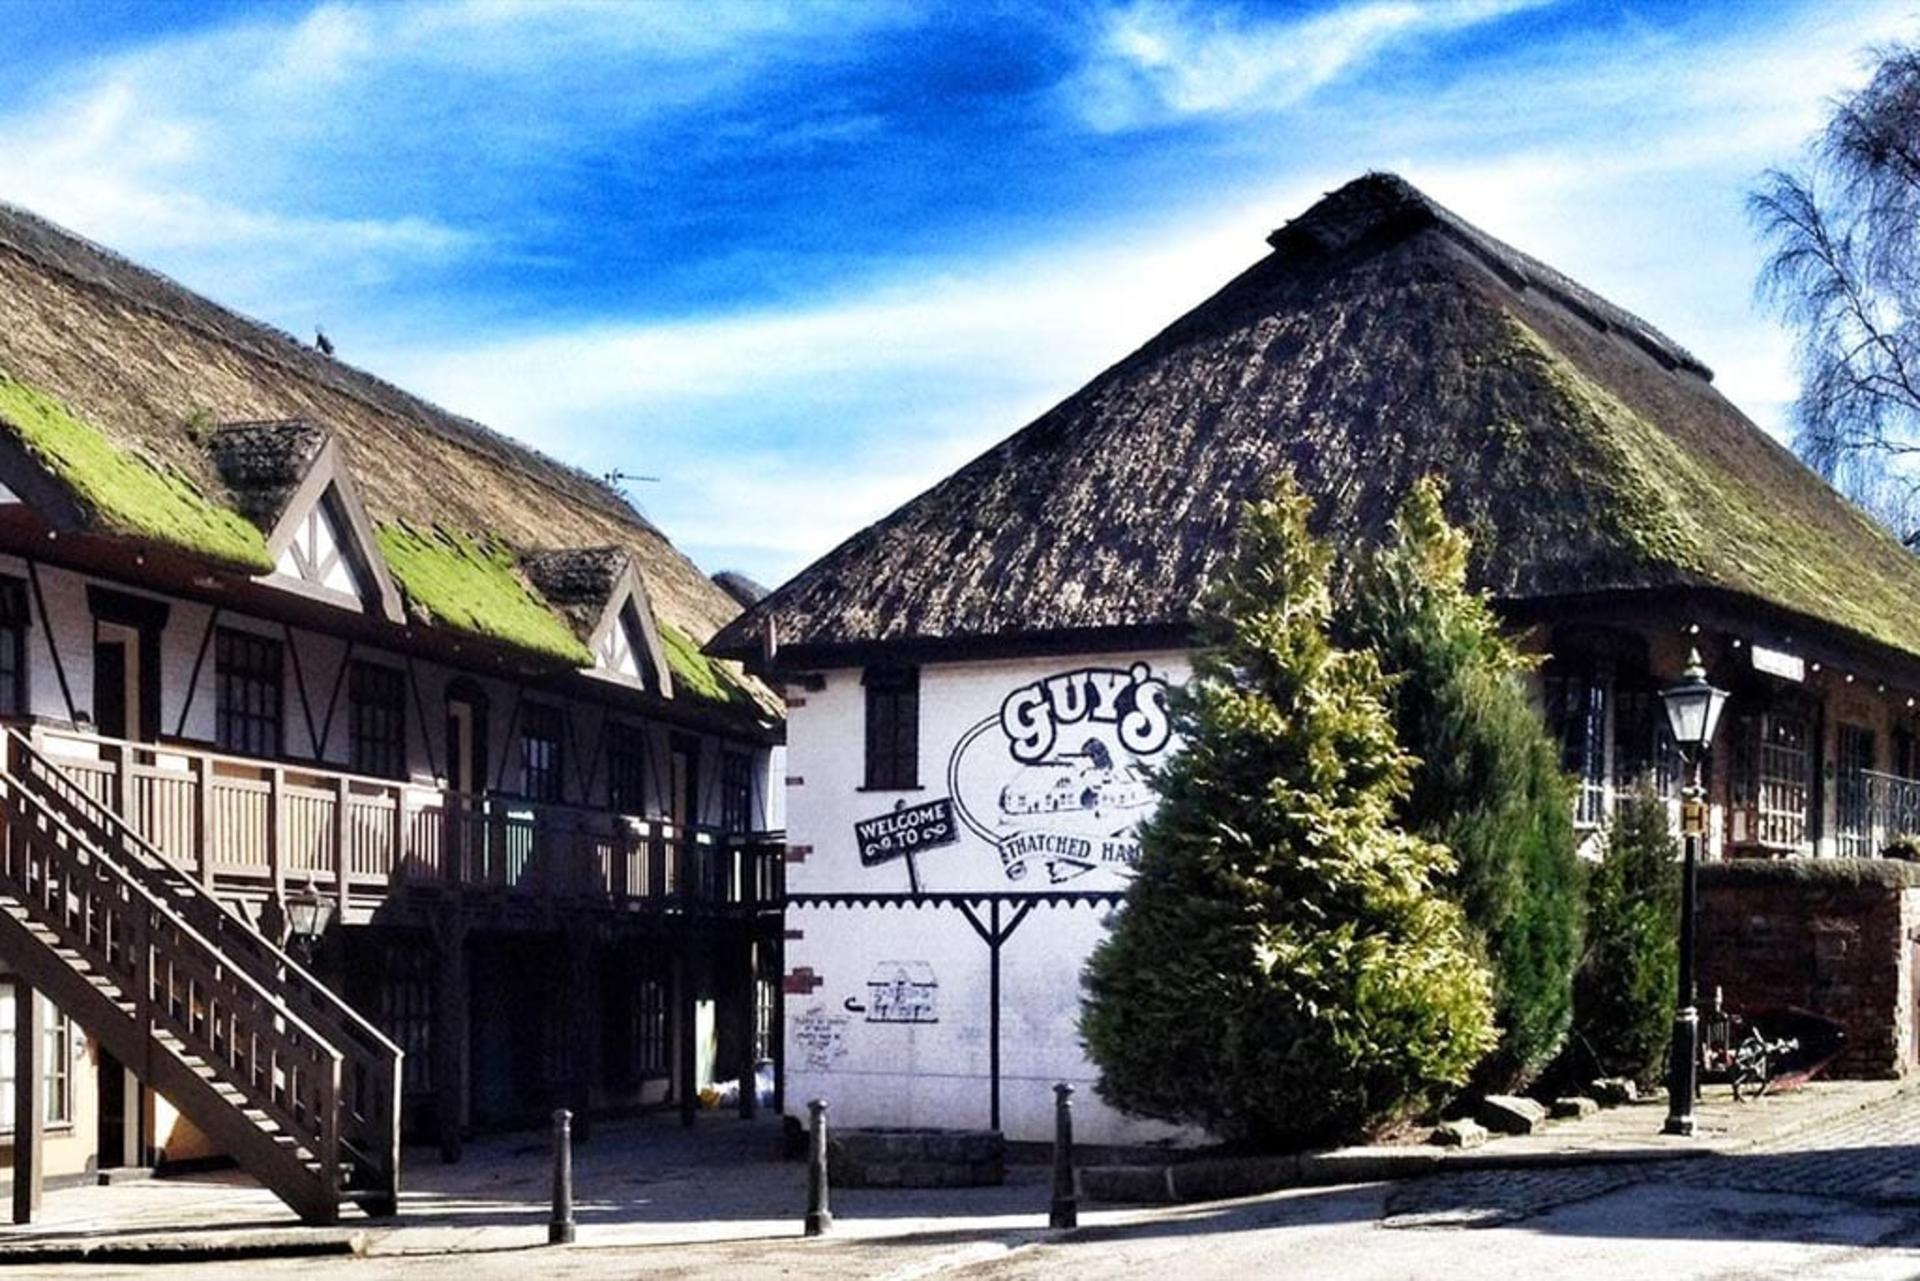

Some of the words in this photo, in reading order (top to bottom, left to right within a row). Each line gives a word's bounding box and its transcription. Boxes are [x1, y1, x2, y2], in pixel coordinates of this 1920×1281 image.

[1001, 661, 1170, 765] GUY'S
[859, 804, 945, 839] WELCOME
[1682, 805, 1703, 830] H
[896, 829, 919, 848] TO
[1005, 833, 1092, 858] THATCHED
[1102, 841, 1141, 863] HAM
